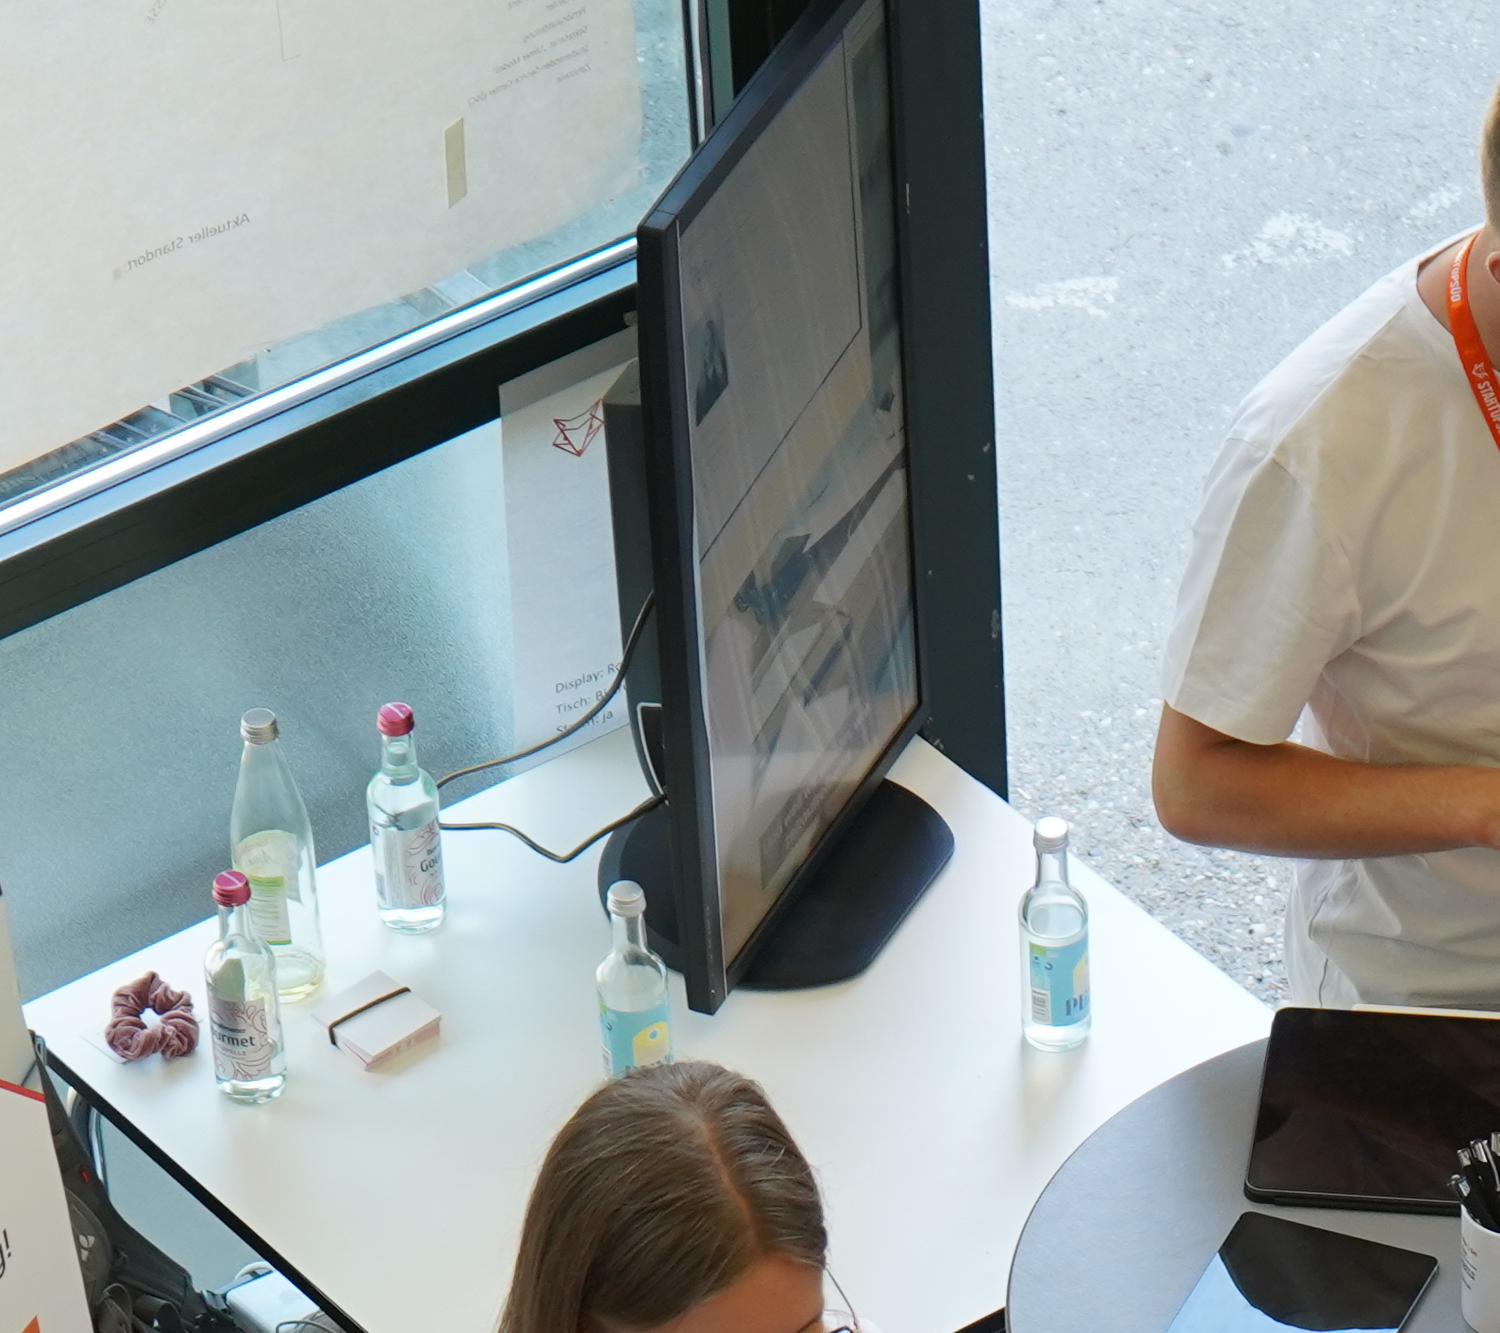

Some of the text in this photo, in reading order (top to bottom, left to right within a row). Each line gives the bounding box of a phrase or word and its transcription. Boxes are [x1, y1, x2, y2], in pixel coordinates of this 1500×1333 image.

[555, 670, 604, 694] Display:
[556, 695, 592, 714] Tisch:
[603, 710, 613, 723] ja
